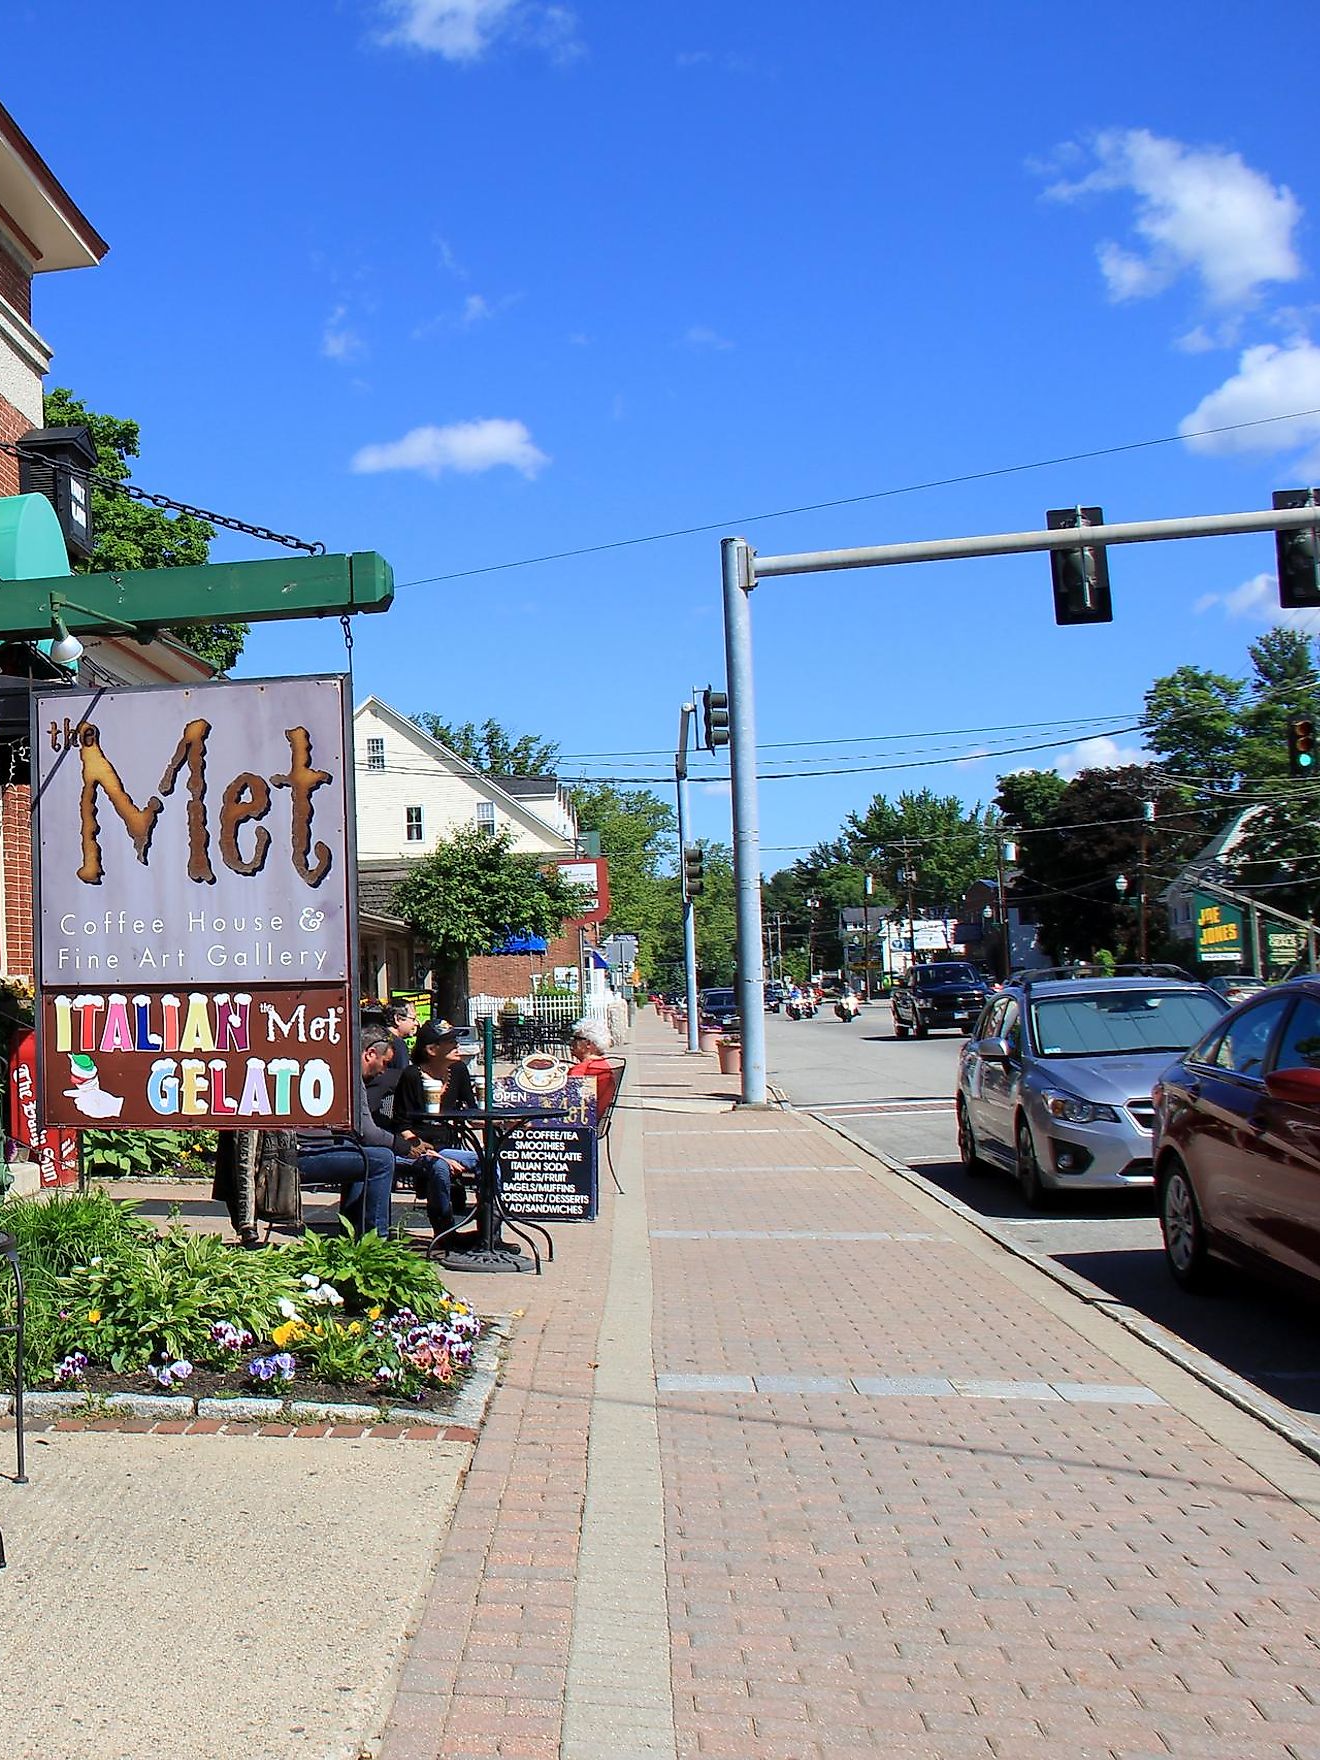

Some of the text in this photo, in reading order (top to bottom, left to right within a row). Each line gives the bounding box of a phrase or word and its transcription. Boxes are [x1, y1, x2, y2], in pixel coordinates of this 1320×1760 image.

[46, 717, 99, 752] the
[76, 717, 334, 889] Met
[60, 907, 325, 937] Coffee House &
[1198, 906, 1221, 926] JOE
[1199, 923, 1238, 945] JONES
[58, 943, 328, 971] Fine Art Gallery
[259, 1002, 274, 1013] the
[53, 992, 253, 1054] ITALIAN
[266, 1004, 341, 1045] Met
[146, 1057, 335, 1118] GELATO
[492, 1092, 527, 1103] OPEN
[13, 1063, 34, 1101] The
[39, 1147, 58, 1183] Sun
[526, 1130, 579, 1140] COFFEE/TEA
[500, 1150, 582, 1161] CED MOCHA/LATTE
[515, 1141, 565, 1151] SMOOTHIES
[511, 1161, 569, 1171] ITALIAN SODA
[512, 1172, 567, 1182] JUICES/FRUIT
[503, 1183, 576, 1193] BAGELS/MUFFINS
[505, 1203, 583, 1214] AD/SANDWICHES
